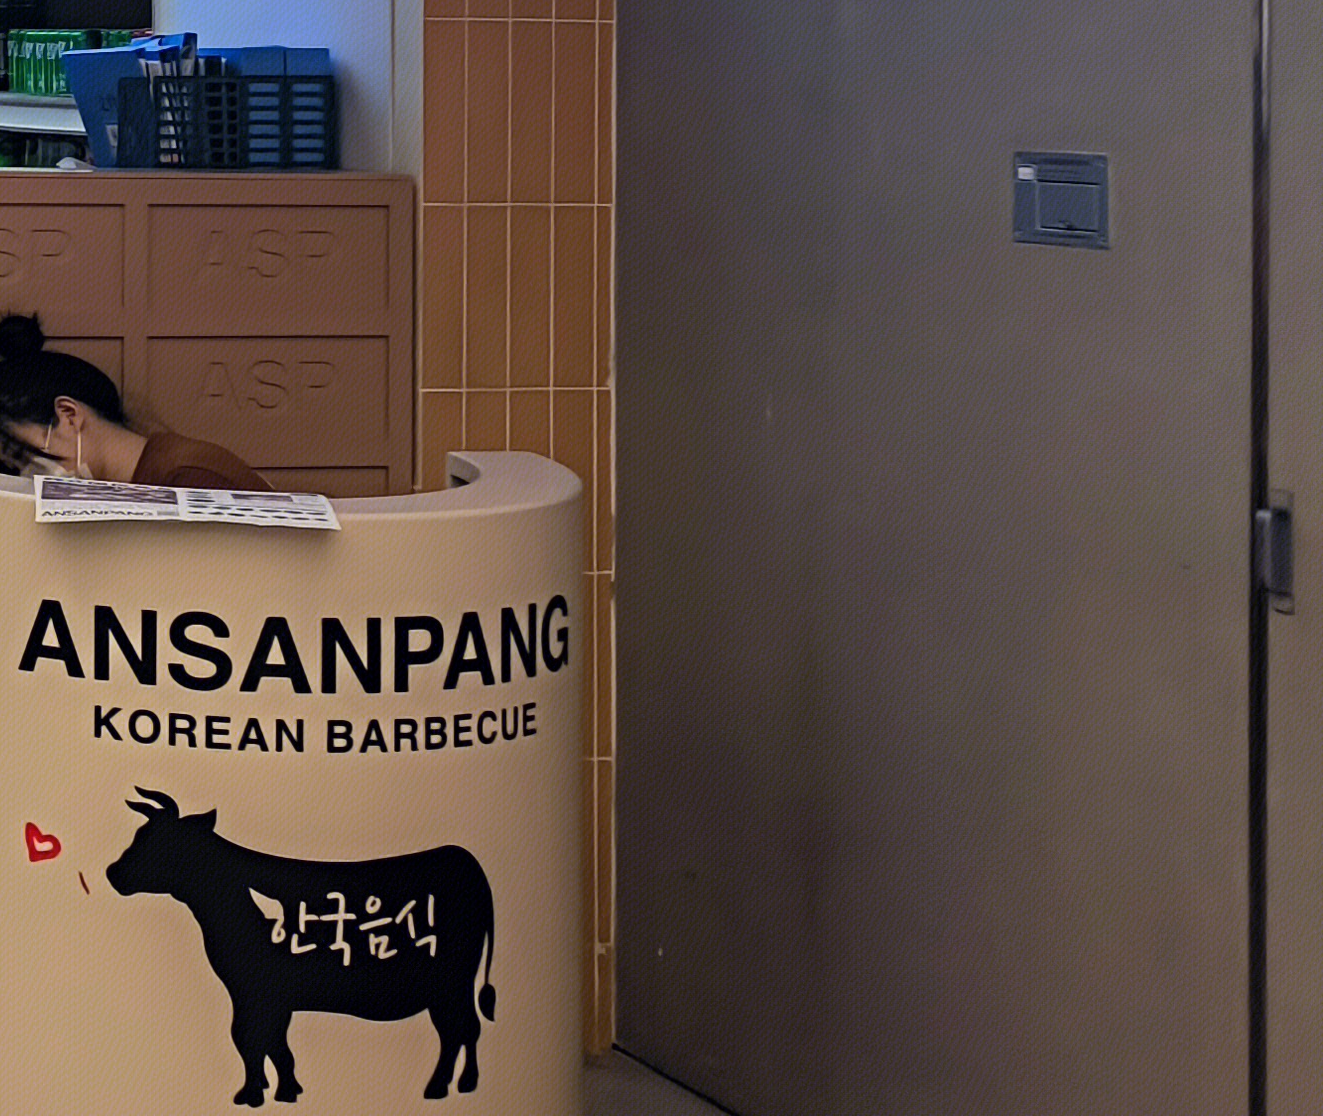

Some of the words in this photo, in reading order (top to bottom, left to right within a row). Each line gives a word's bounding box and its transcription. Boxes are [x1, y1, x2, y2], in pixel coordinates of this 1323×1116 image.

[203, 228, 339, 281] ASP
[18, 594, 571, 695] ANSANPANG
[92, 704, 306, 754] KOREAN
[325, 702, 539, 754] BARBECUE
[269, 891, 439, 967] 한국음식
